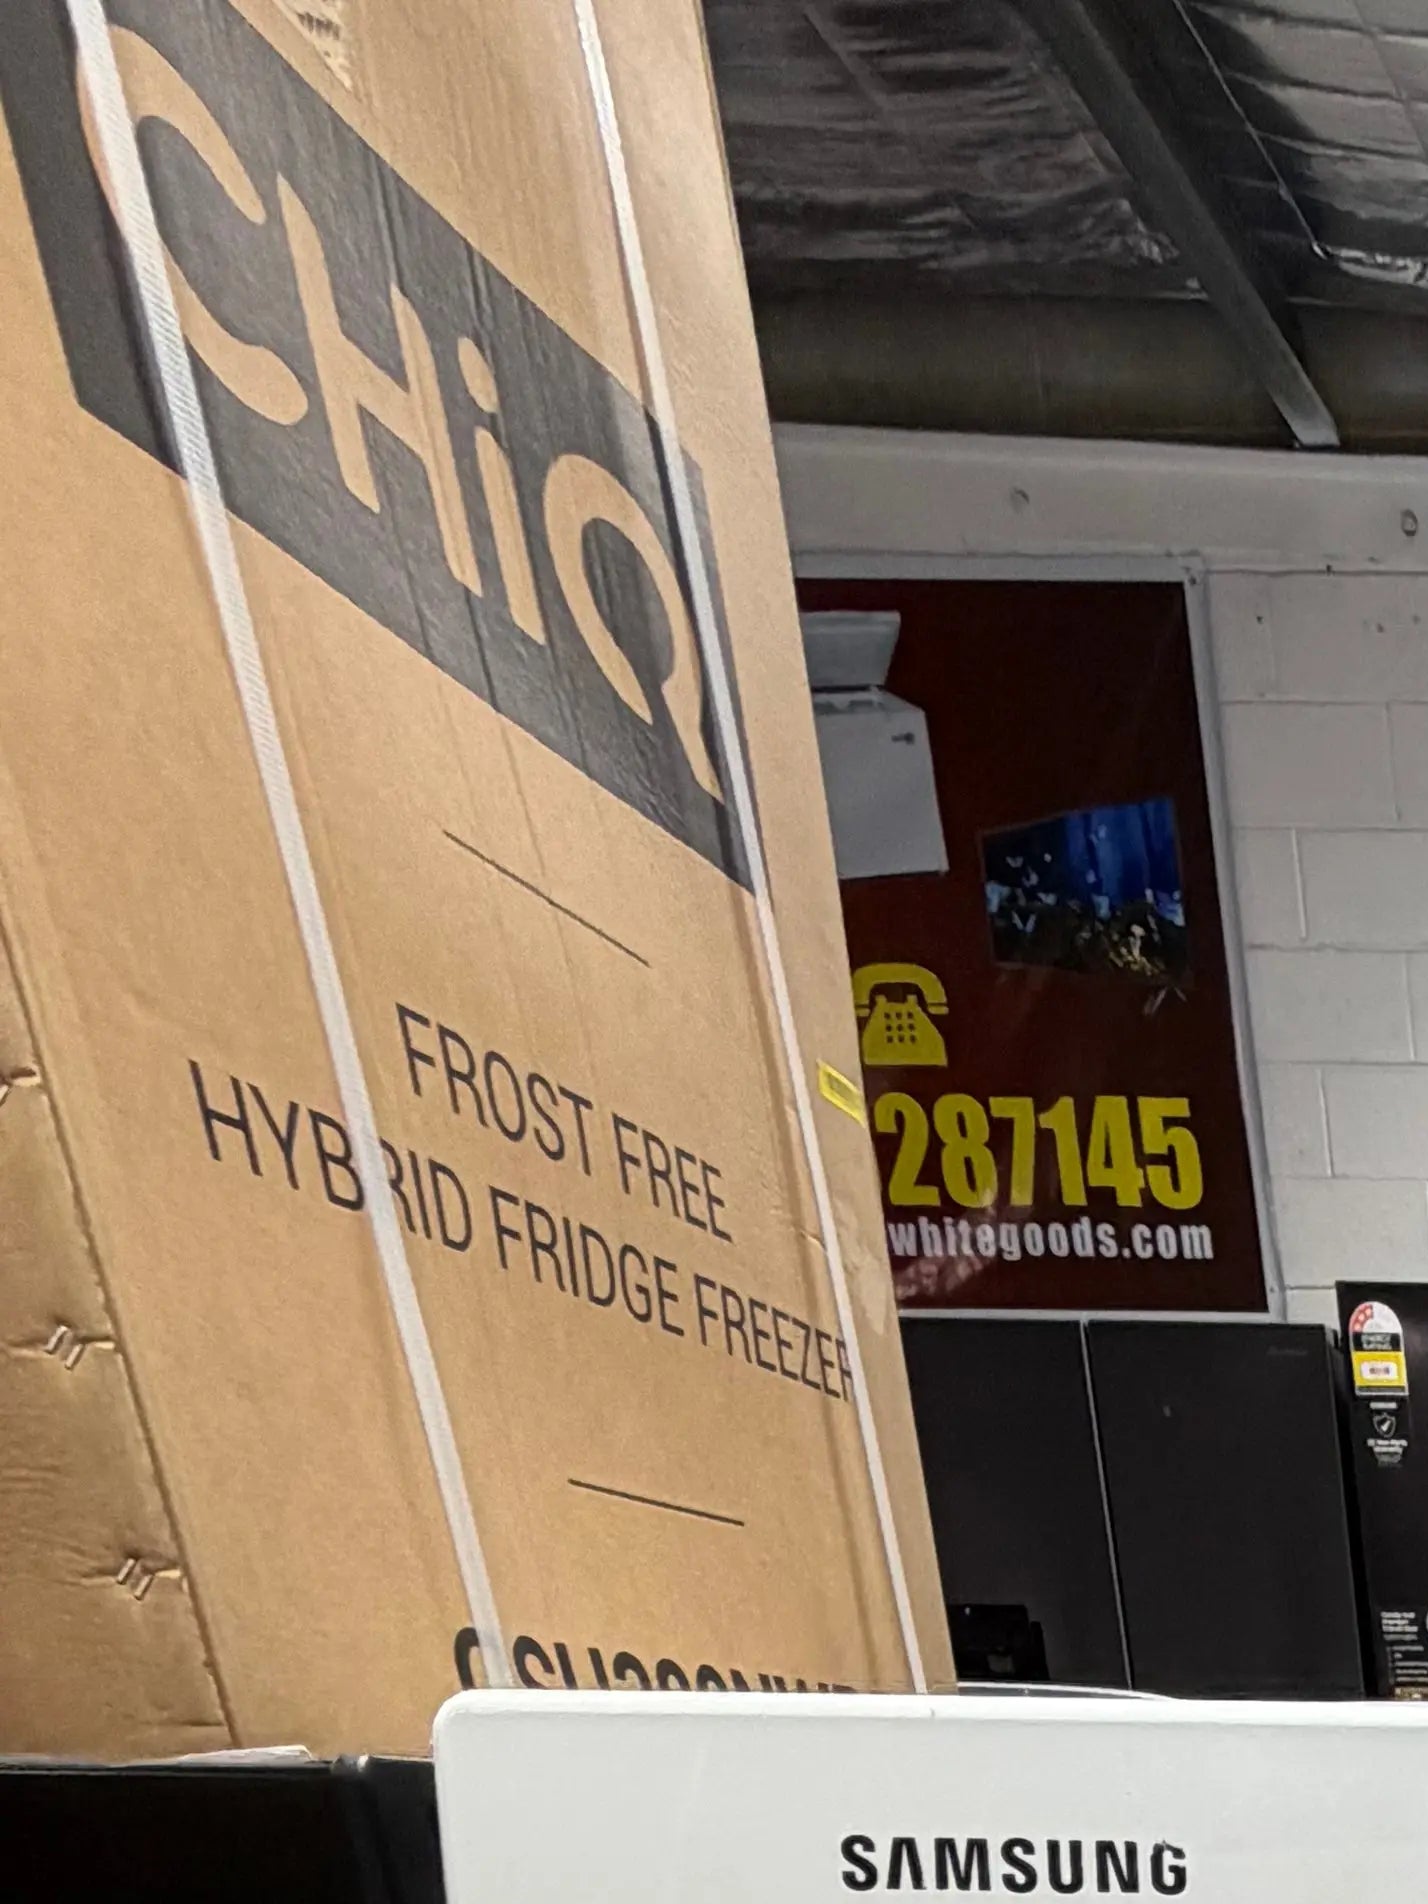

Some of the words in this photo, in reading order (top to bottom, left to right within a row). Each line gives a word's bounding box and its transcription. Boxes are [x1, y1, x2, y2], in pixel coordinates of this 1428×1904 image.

[75, 22, 724, 804] CHiQ
[189, 1060, 472, 1232] HYBRID
[488, 1184, 684, 1337] FRIDGE
[396, 1003, 592, 1176] FROST
[612, 1112, 733, 1243] FREE
[875, 1092, 1204, 1210] 287145
[840, 1834, 1188, 1895] SAMSUNG
